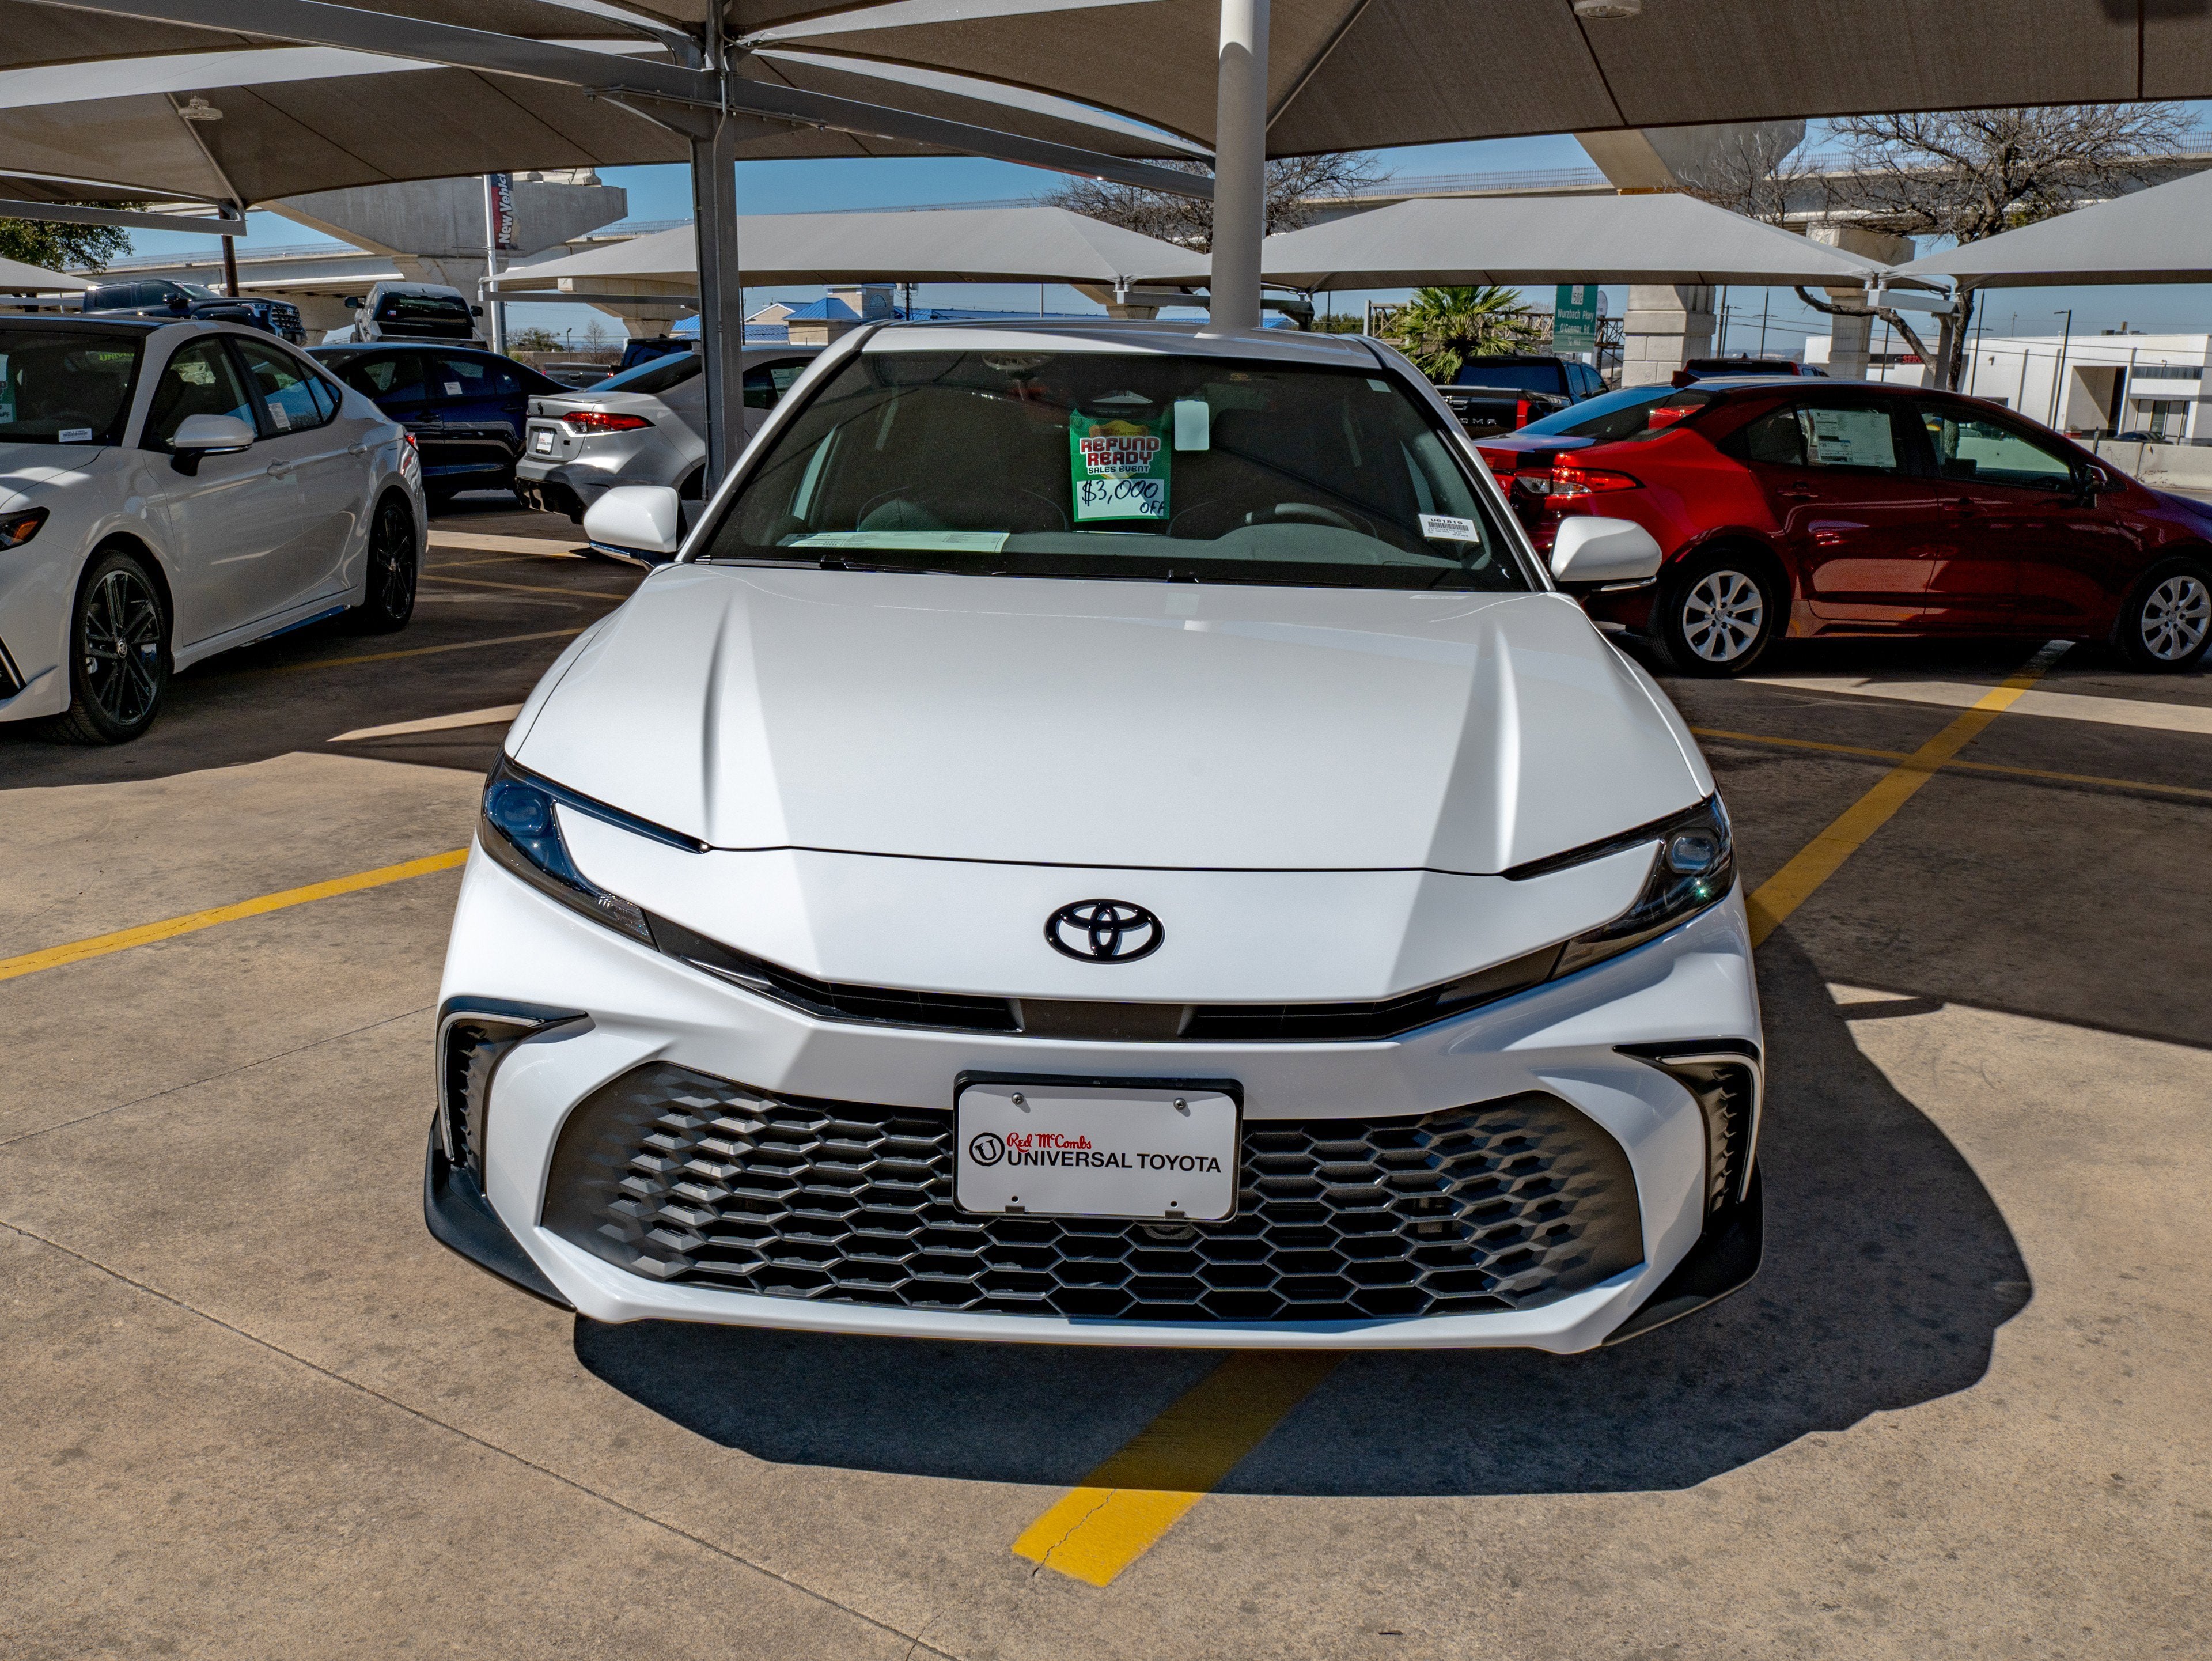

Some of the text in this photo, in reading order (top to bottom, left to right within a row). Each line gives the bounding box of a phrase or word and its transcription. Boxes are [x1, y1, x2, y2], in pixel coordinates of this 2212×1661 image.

[498, 215, 512, 243] New
[1558, 308, 1594, 323] Wurzbach Pkwy
[1584, 324, 1590, 334] Rd
[1080, 438, 1160, 453] REFUND
[1087, 452, 1152, 466] READY
[1081, 480, 1159, 506] $3,000
[1006, 1132, 1092, 1153] Red McCombs
[1007, 1150, 1221, 1173] UNIVERSAL TOYOTA
